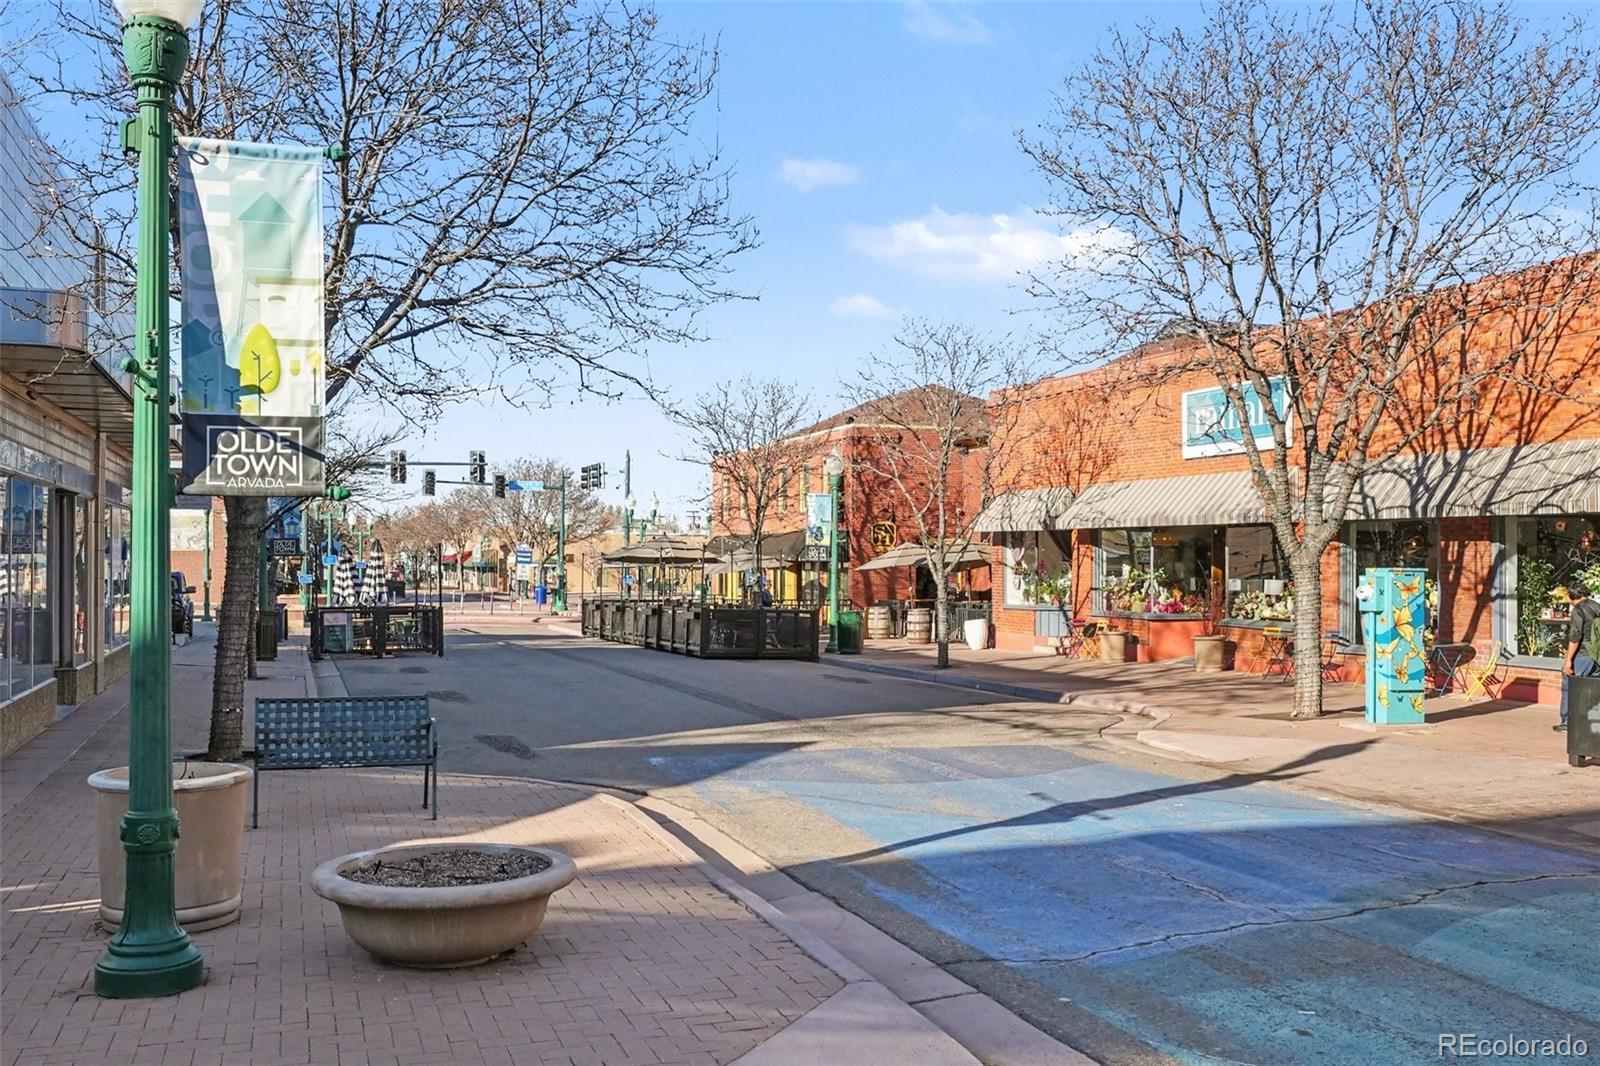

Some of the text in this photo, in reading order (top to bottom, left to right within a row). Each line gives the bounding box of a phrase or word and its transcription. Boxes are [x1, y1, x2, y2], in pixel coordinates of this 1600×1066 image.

[217, 430, 292, 453] OLDE
[211, 454, 297, 476] TOWN
[226, 477, 285, 488] ARVADA
